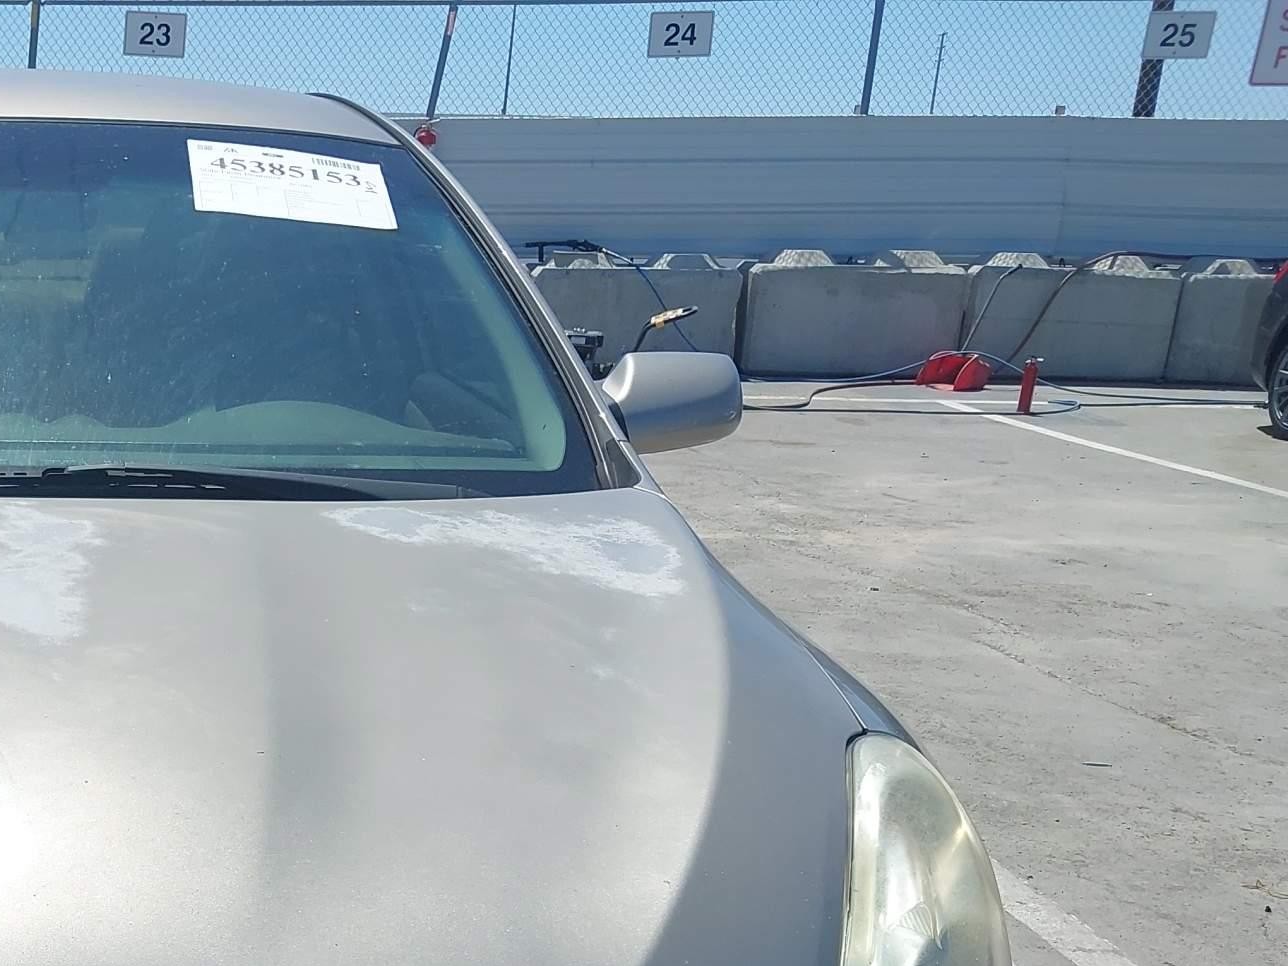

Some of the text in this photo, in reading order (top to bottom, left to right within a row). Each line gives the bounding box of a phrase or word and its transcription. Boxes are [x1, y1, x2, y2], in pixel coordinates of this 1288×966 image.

[139, 22, 171, 47] 23
[664, 23, 697, 47] 24
[1159, 23, 1198, 48] 25
[210, 156, 361, 188] 45385153
